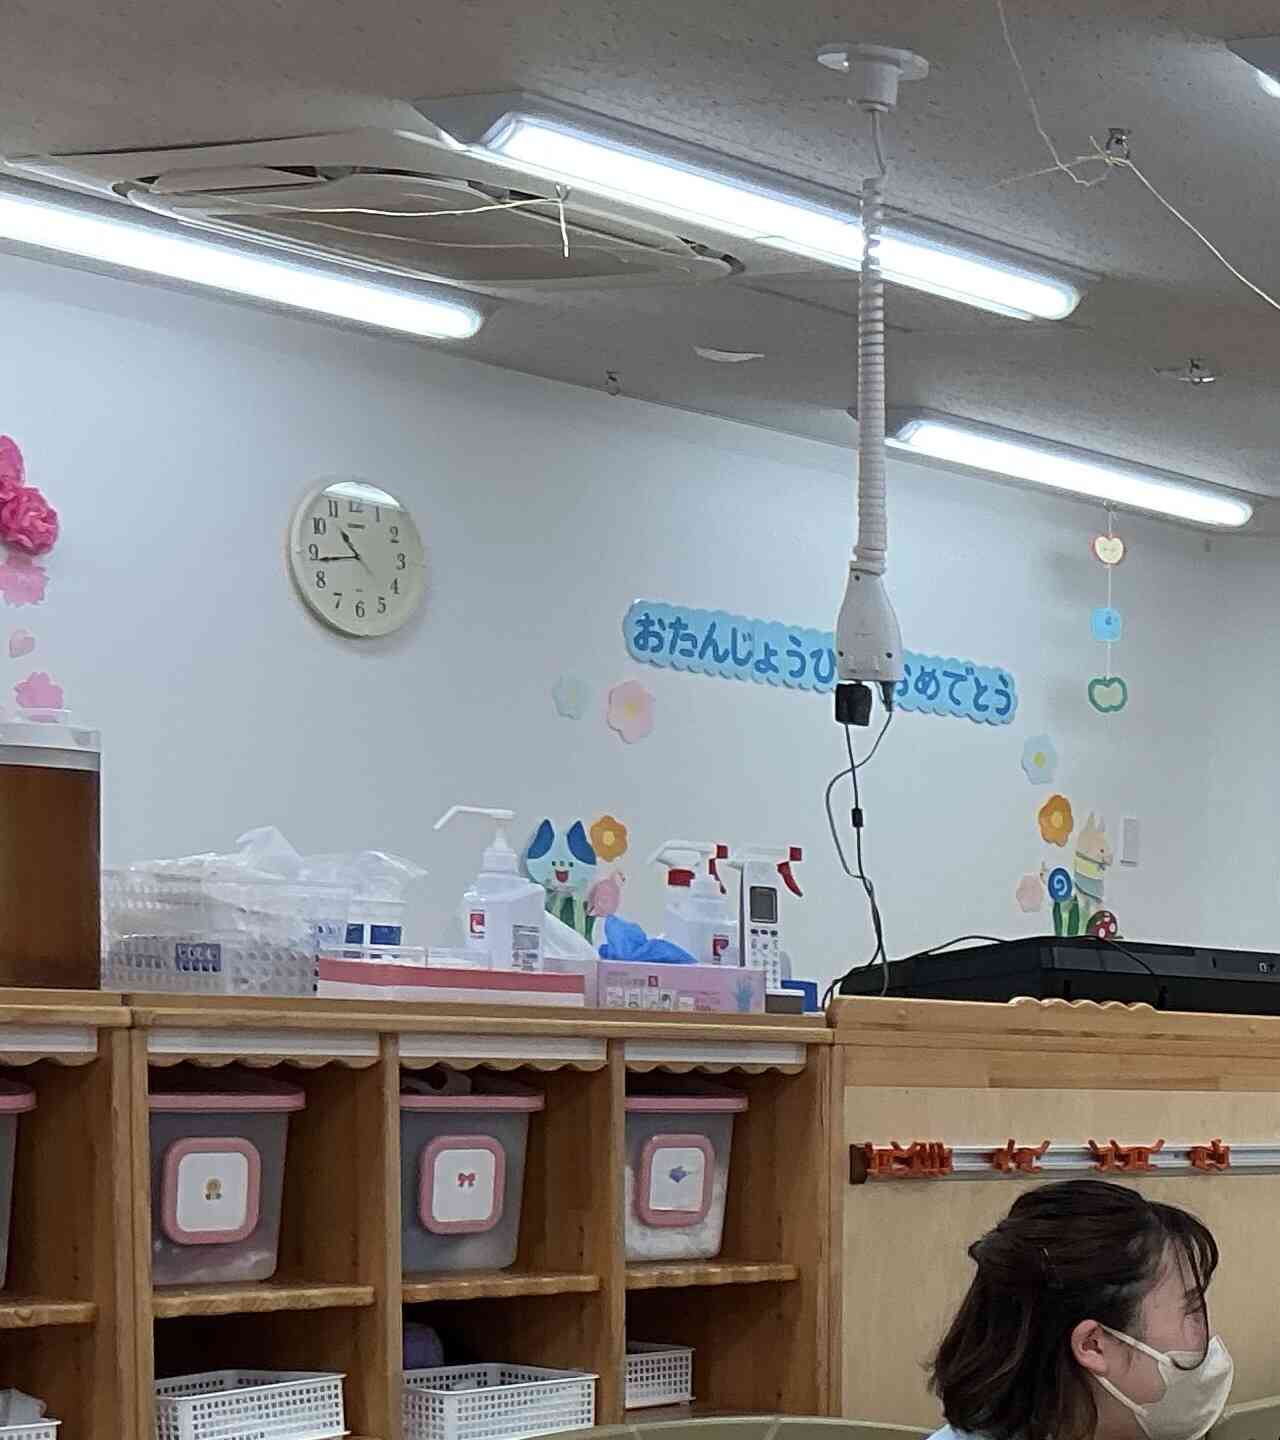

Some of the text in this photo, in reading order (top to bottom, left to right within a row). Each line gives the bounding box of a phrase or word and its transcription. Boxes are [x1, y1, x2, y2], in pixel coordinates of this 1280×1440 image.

[328, 500, 338, 518] 11
[375, 506, 381, 522] 1
[313, 517, 327, 535] 10
[389, 526, 400, 543] 2
[308, 544, 319, 561] 9
[396, 553, 406, 570] 3
[316, 570, 326, 588] 8
[390, 578, 399, 594] 4
[333, 592, 342, 609] 7
[377, 597, 386, 613] 5
[355, 601, 365, 618] 6
